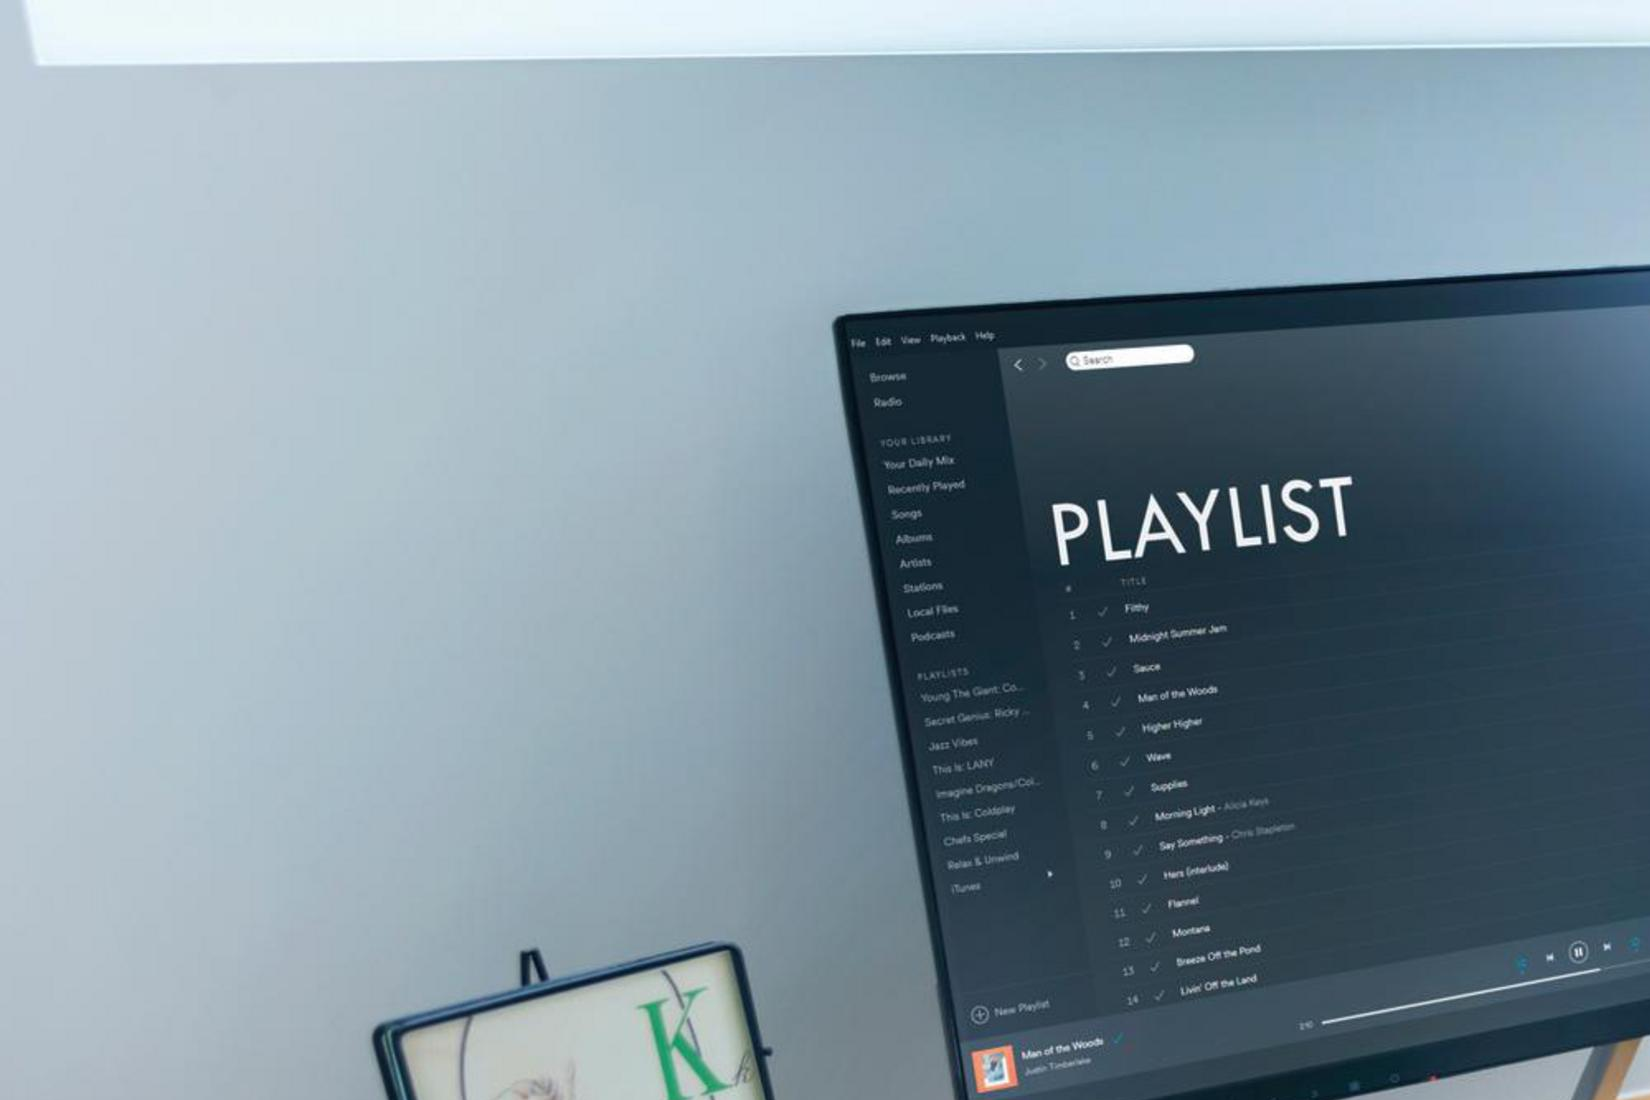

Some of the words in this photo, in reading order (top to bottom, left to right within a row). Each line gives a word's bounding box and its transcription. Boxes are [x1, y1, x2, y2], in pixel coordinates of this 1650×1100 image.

[851, 338, 866, 348] File
[876, 336, 892, 347] Edit
[901, 335, 921, 345] View
[930, 331, 966, 344] Playback
[975, 330, 995, 342] Help
[1082, 354, 1113, 366] Search
[869, 371, 907, 383] Browse
[874, 397, 902, 408] Radio
[880, 437, 908, 447] YOUR
[911, 433, 951, 446] LIBRARY
[884, 458, 906, 471] Your
[908, 456, 934, 470] Daily
[936, 455, 955, 466] Mix
[888, 482, 930, 497] Recently
[932, 479, 966, 493] Played
[891, 507, 923, 522] Songs
[1052, 476, 1353, 566] PLAYLIST
[895, 532, 933, 544] Albums
[900, 556, 932, 569] Artists
[902, 580, 943, 594] Stations
[1121, 577, 1147, 587] TITLE
[906, 605, 934, 618] Local
[936, 603, 959, 615] Files
[1070, 610, 1076, 620] 1
[1125, 602, 1149, 614] Filthy
[910, 628, 956, 642] Podcasts
[1129, 630, 1170, 644] Midnight
[1170, 625, 1206, 638] Summer
[1208, 623, 1228, 634] Jam
[917, 668, 969, 681] PLAYLISTS
[1133, 662, 1161, 674] Sauce
[920, 690, 950, 704] Young
[952, 688, 970, 698] The
[1138, 692, 1158, 704] Man
[1160, 690, 1170, 701] of
[1172, 688, 1186, 699] the
[1187, 685, 1218, 697] Woods
[924, 715, 956, 728] Secret
[994, 708, 1020, 720] Ricky
[1142, 721, 1172, 735] Higher
[1173, 717, 1203, 731] Higher
[928, 741, 950, 752] Jazz
[952, 737, 978, 749] Vibes
[1146, 752, 1172, 763] Wave
[932, 765, 952, 776] This
[966, 758, 994, 771] LANY
[936, 786, 974, 800] Imagine
[1151, 779, 1188, 793] Supplies
[940, 812, 960, 824] This
[974, 805, 1016, 819] Coldplay
[1154, 809, 1192, 822] Morning
[1194, 804, 1216, 818] Light
[1249, 797, 1269, 808] Keys
[972, 830, 1008, 844] Special
[1159, 841, 1176, 852] Say
[1178, 833, 1224, 849] Something
[1256, 822, 1296, 837] Stapleton
[947, 859, 972, 870] Relax
[984, 852, 1020, 866] Unwind
[1110, 878, 1122, 890] 10
[1163, 869, 1184, 880] Hers
[951, 882, 982, 894] iTunes
[1114, 908, 1127, 920] 11
[1168, 896, 1200, 910] Flannel
[1118, 936, 1130, 948] 12
[1172, 924, 1211, 938] Montana
[1176, 955, 1206, 968] Breeze
[1207, 951, 1222, 962] Off
[1223, 948, 1238, 959] the
[1239, 944, 1262, 956] Pond
[1204, 980, 1220, 992] Off
[1220, 978, 1235, 988] the
[1236, 974, 1258, 986] Land
[994, 1006, 1016, 1017] New
[1018, 1000, 1051, 1015] Playlist
[1021, 1049, 1042, 1060] Man
[1044, 1046, 1054, 1057] of
[1056, 1043, 1071, 1054] the
[1072, 1037, 1104, 1052] Woods
[1050, 1056, 1092, 1072] Timberlake
